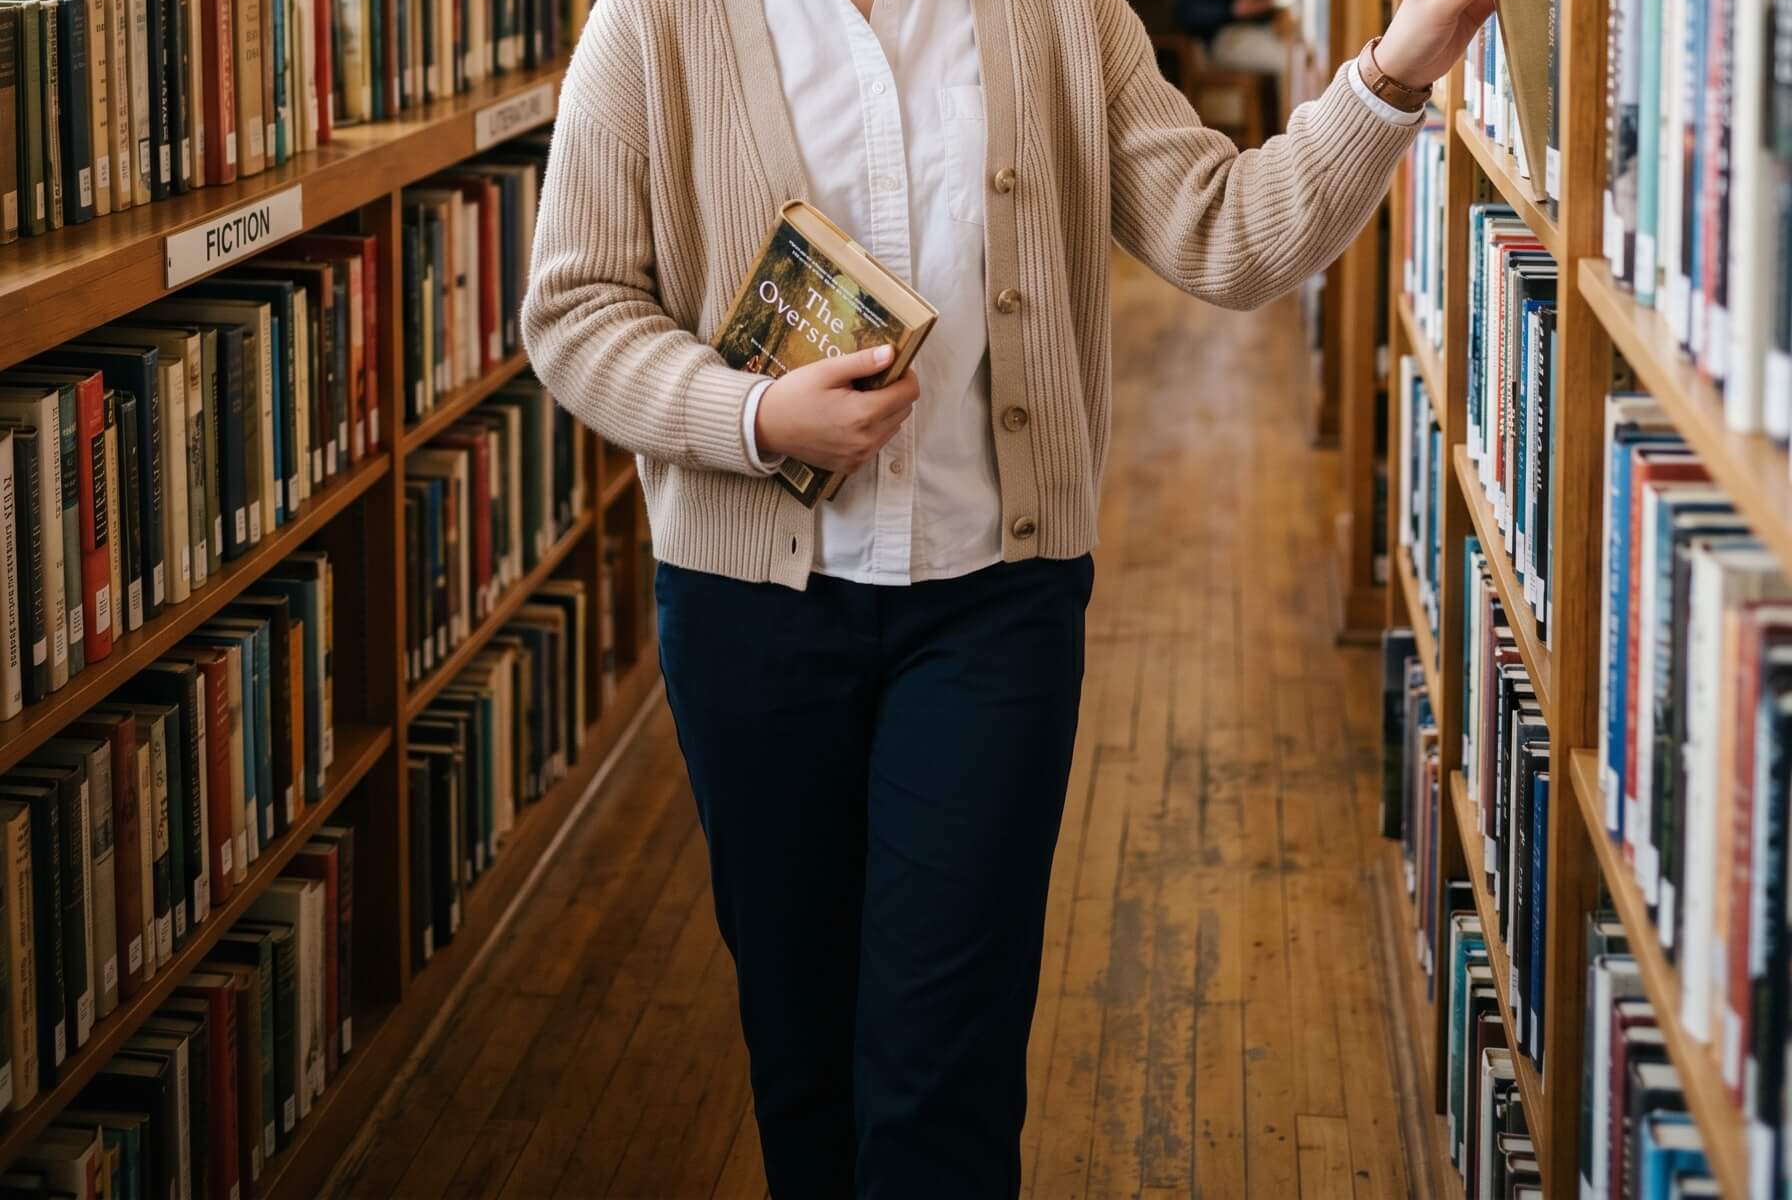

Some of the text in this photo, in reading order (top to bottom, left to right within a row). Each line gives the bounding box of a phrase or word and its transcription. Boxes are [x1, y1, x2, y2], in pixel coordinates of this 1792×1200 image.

[206, 206, 270, 261] FICTION
[760, 280, 845, 359] Oversto
[806, 287, 844, 334] The
